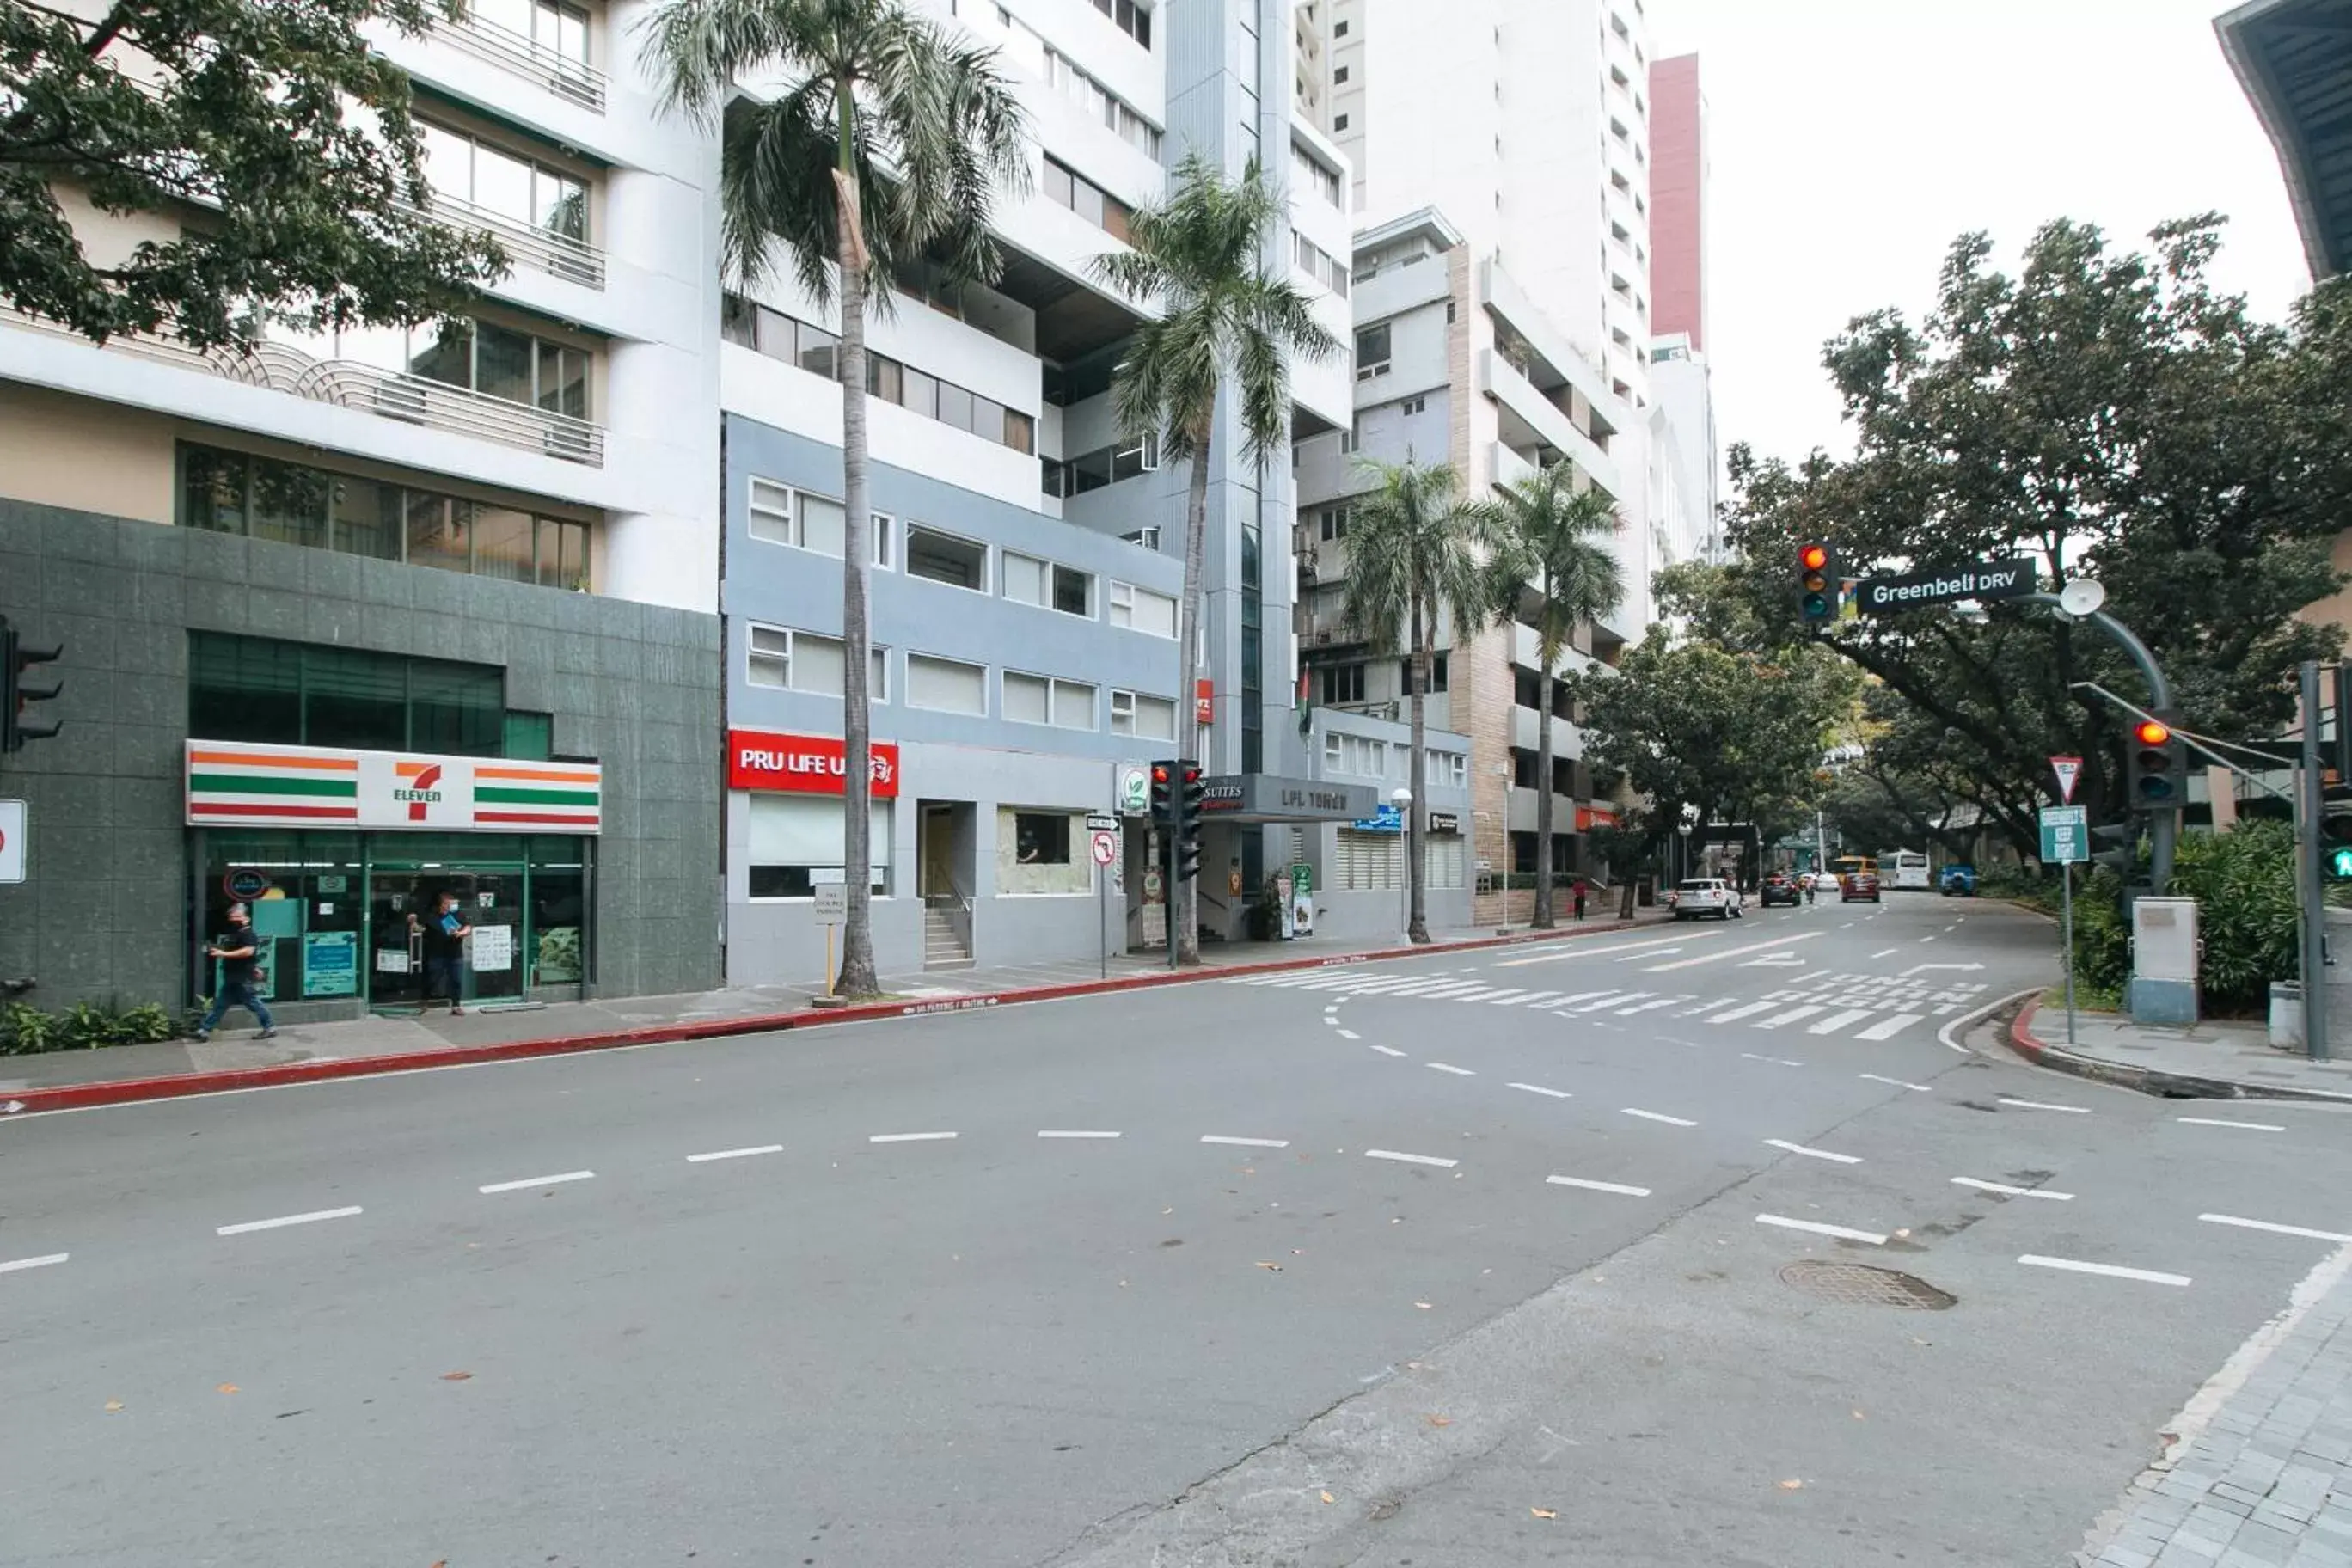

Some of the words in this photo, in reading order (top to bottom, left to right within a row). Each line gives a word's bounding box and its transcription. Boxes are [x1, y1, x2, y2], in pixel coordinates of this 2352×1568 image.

[1873, 573, 1976, 603] Greenbelt
[1979, 570, 2017, 591] DRV
[740, 749, 784, 771] PRU
[788, 753, 826, 774] LIFE
[830, 757, 846, 775] U
[396, 762, 442, 821] 7
[1204, 786, 1243, 799] SUITES
[1282, 789, 1305, 808] LPL
[1810, 982, 1975, 1003] TURN
[1829, 973, 1989, 992] ONLY
[1761, 989, 1974, 1015] RIGHT
